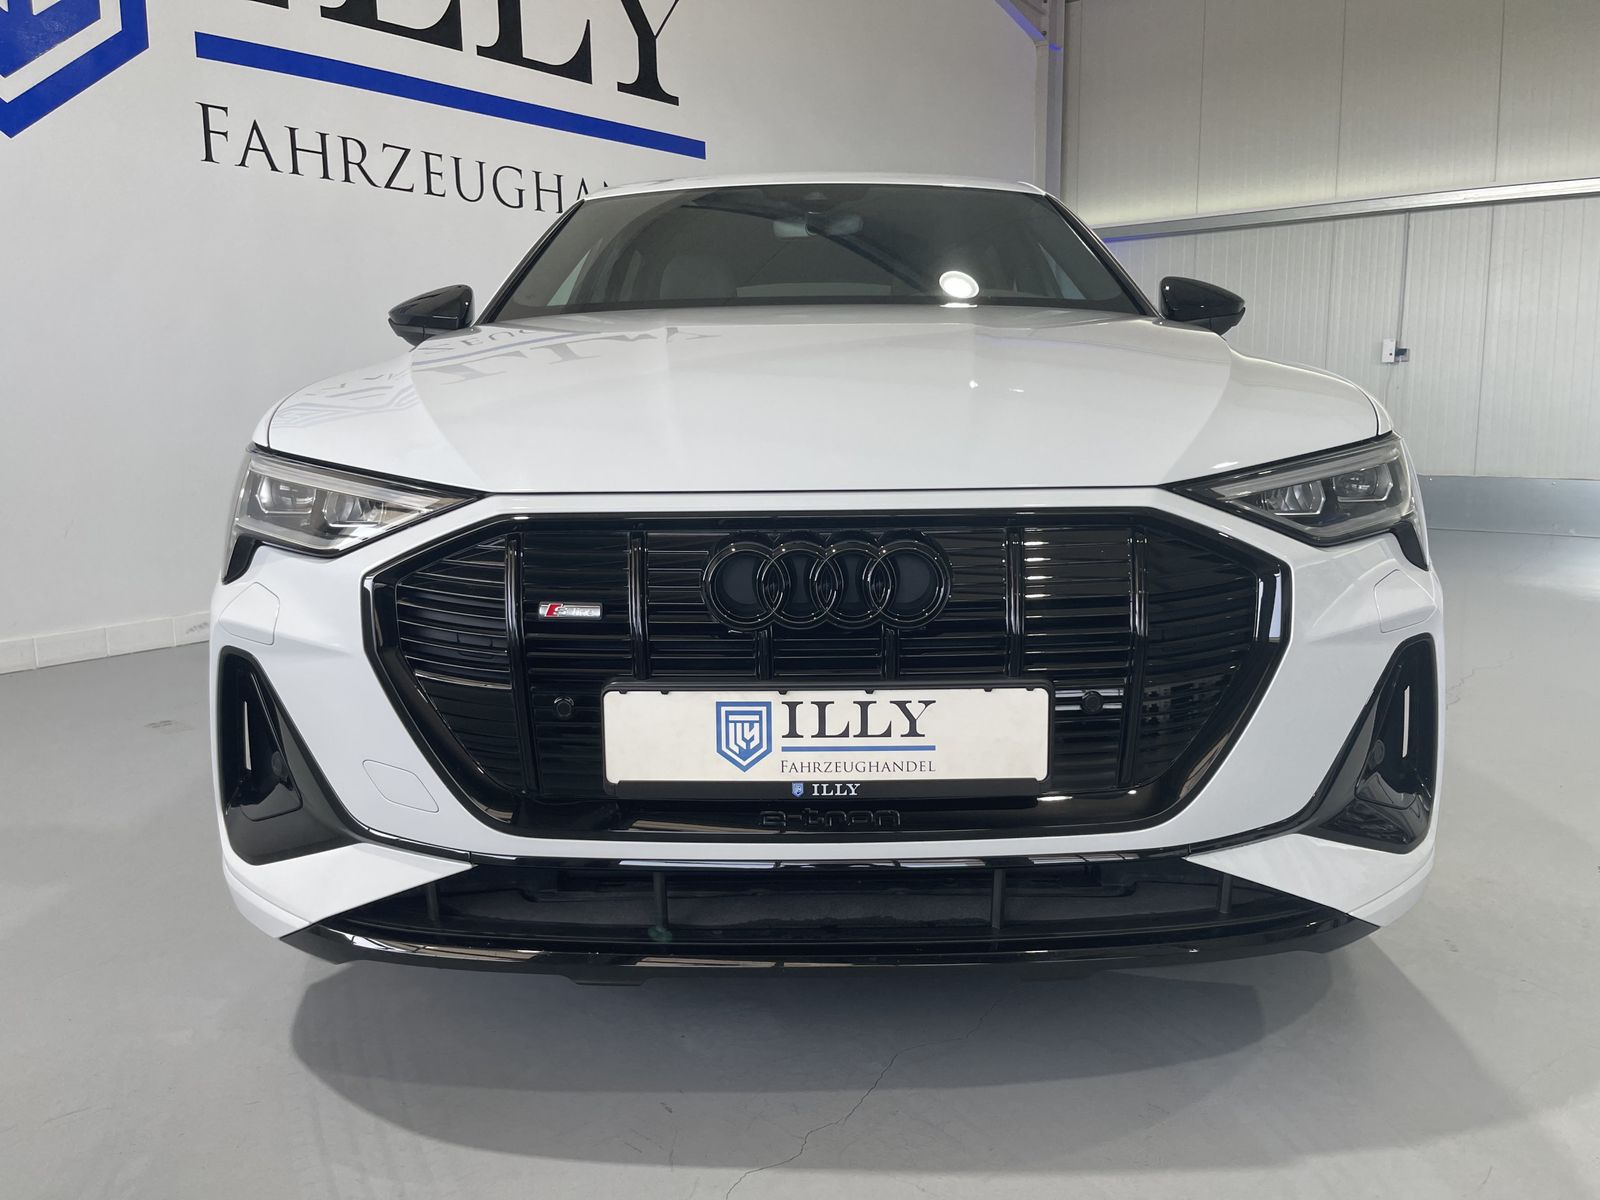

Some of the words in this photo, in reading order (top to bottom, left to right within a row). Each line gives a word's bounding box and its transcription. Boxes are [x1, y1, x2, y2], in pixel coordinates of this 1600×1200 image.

[781, 700, 936, 738] ILLY
[780, 759, 936, 774] FAHRZEUGHANDEL
[812, 783, 860, 796] ILLY
